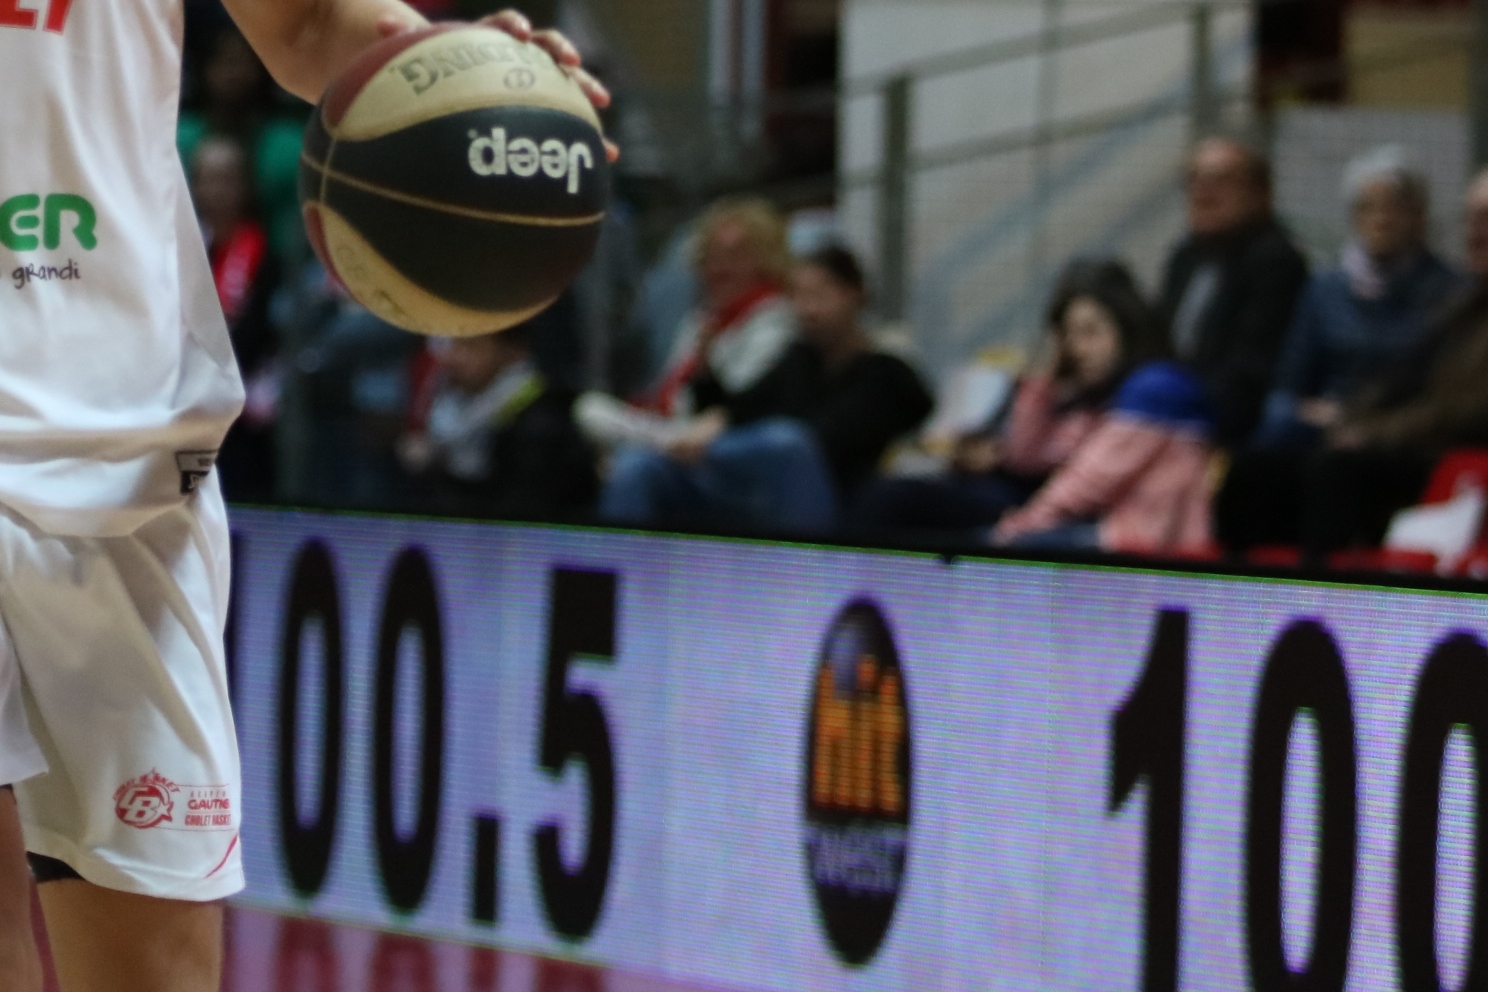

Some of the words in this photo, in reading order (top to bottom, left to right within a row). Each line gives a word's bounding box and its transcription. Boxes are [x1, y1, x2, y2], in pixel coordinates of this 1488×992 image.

[468, 127, 594, 194] Jeep
[225, 530, 620, 946] 00.5
[1109, 605, 1488, 992] 100
